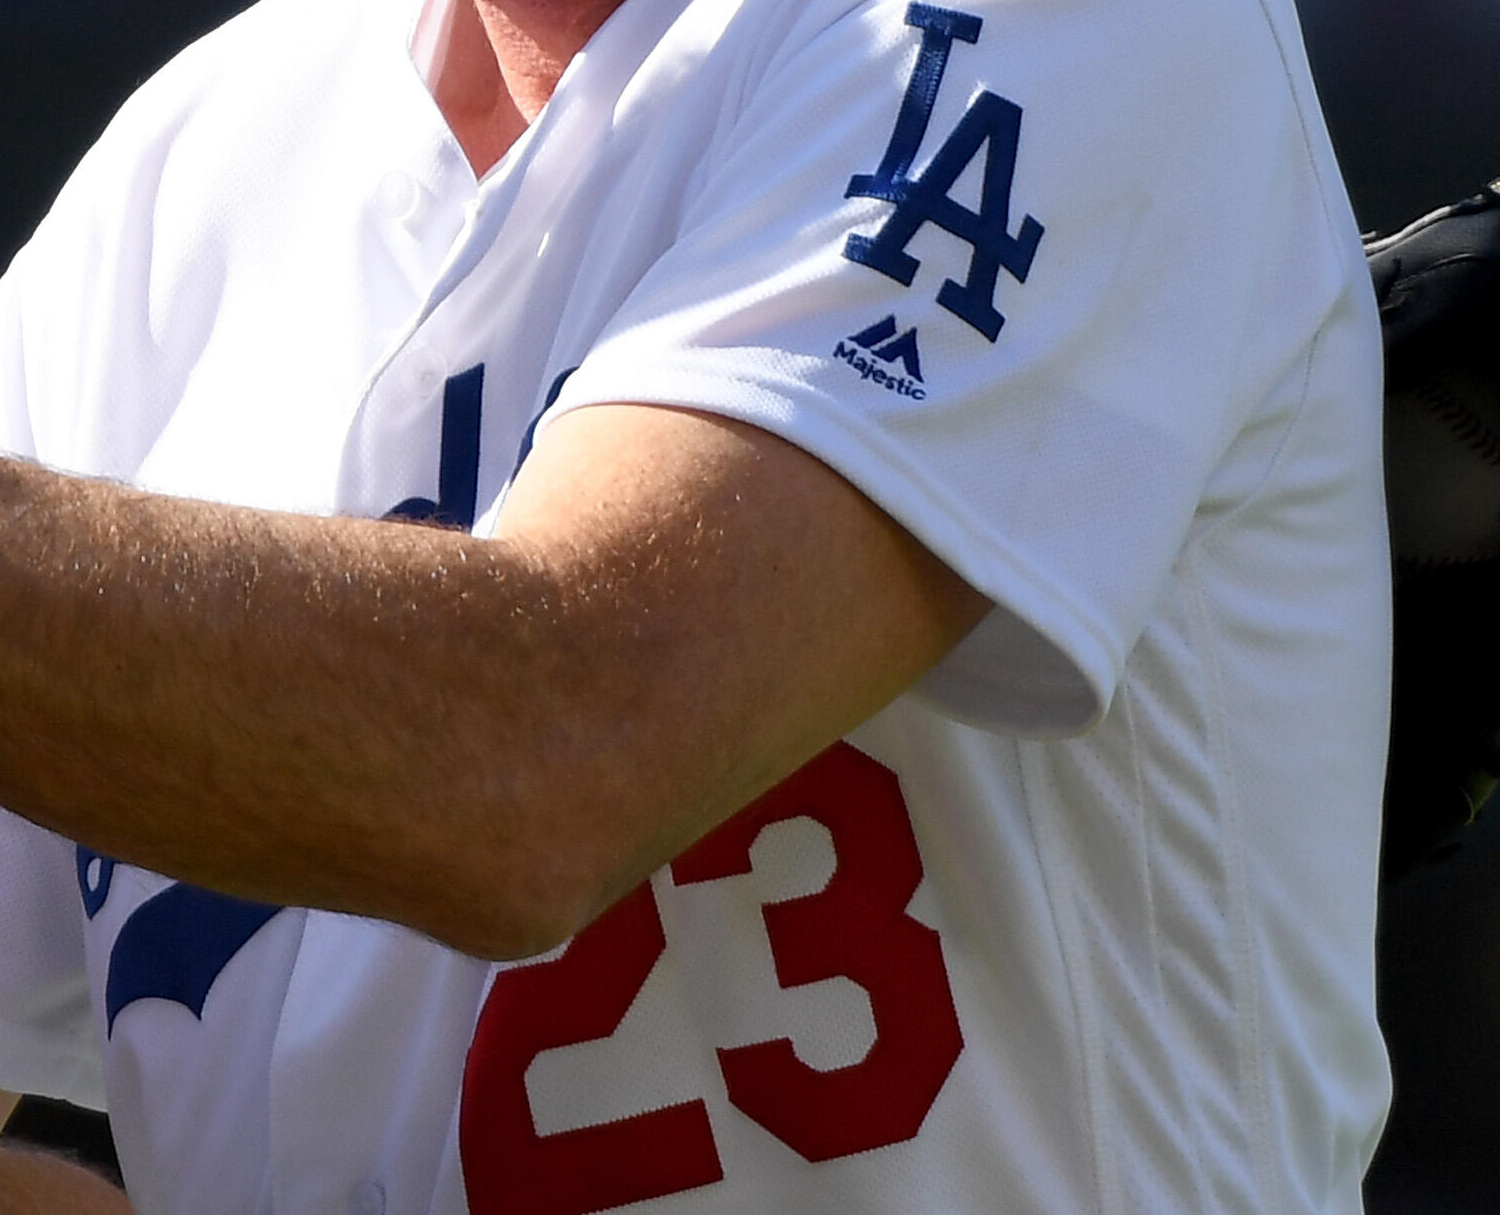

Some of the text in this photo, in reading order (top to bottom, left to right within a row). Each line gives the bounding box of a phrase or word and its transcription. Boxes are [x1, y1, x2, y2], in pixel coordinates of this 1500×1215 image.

[840, 0, 1046, 345] LA
[832, 340, 927, 401] Majestic
[458, 738, 965, 1215] 23
